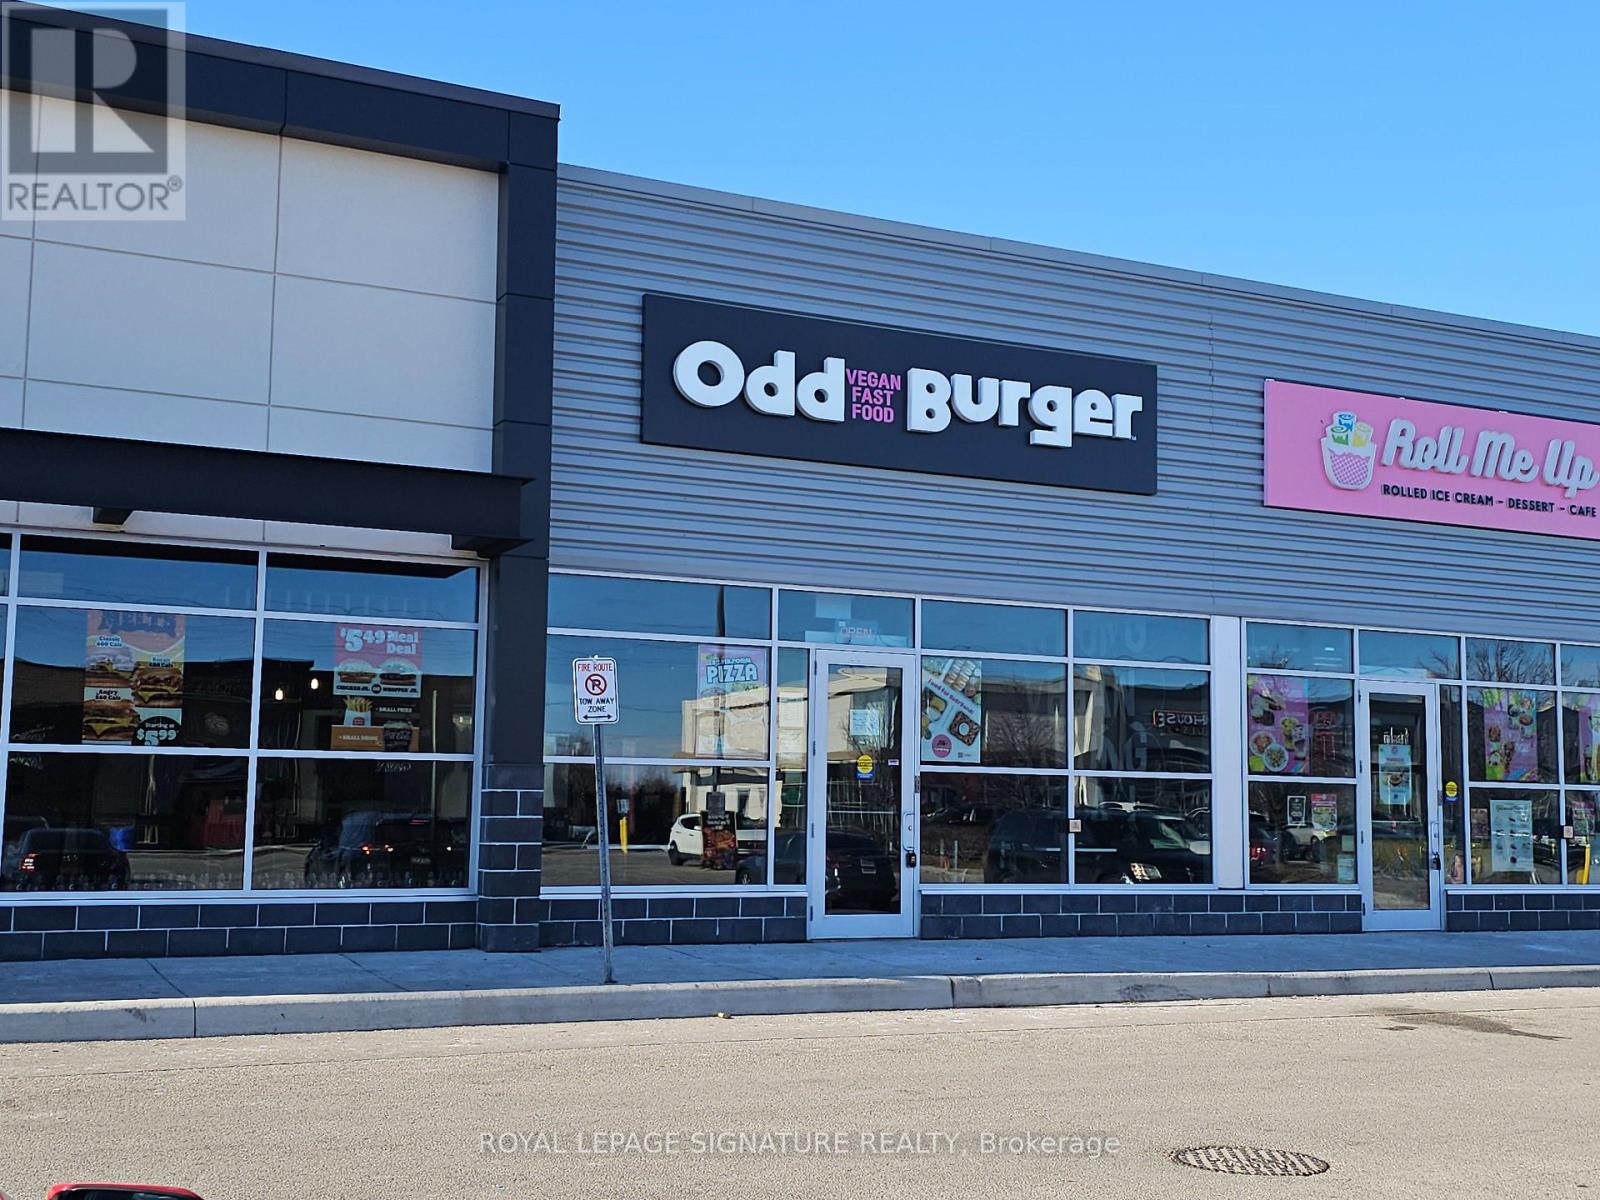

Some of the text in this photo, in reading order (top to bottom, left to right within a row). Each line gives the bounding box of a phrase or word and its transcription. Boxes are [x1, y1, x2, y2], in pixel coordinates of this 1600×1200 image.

[846, 368, 901, 391] VEGAN
[673, 340, 1143, 448] Odd Burger
[851, 387, 894, 406] FAST
[852, 404, 894, 423] FOOD
[1381, 418, 1600, 498] Roll Me Up
[1382, 484, 1428, 499] ROLLED
[1431, 489, 1451, 502] ICE
[1454, 492, 1494, 506] CREAM
[1508, 497, 1555, 513] DESSERT
[1569, 504, 1597, 518] CAFE
[387, 630, 419, 643] Meal
[386, 643, 417, 655] Deal
[577, 663, 614, 672] FIRE ROUTE
[706, 663, 758, 684] PIZZA
[578, 697, 615, 705] TOW AWAY
[587, 705, 607, 713] ZONE
